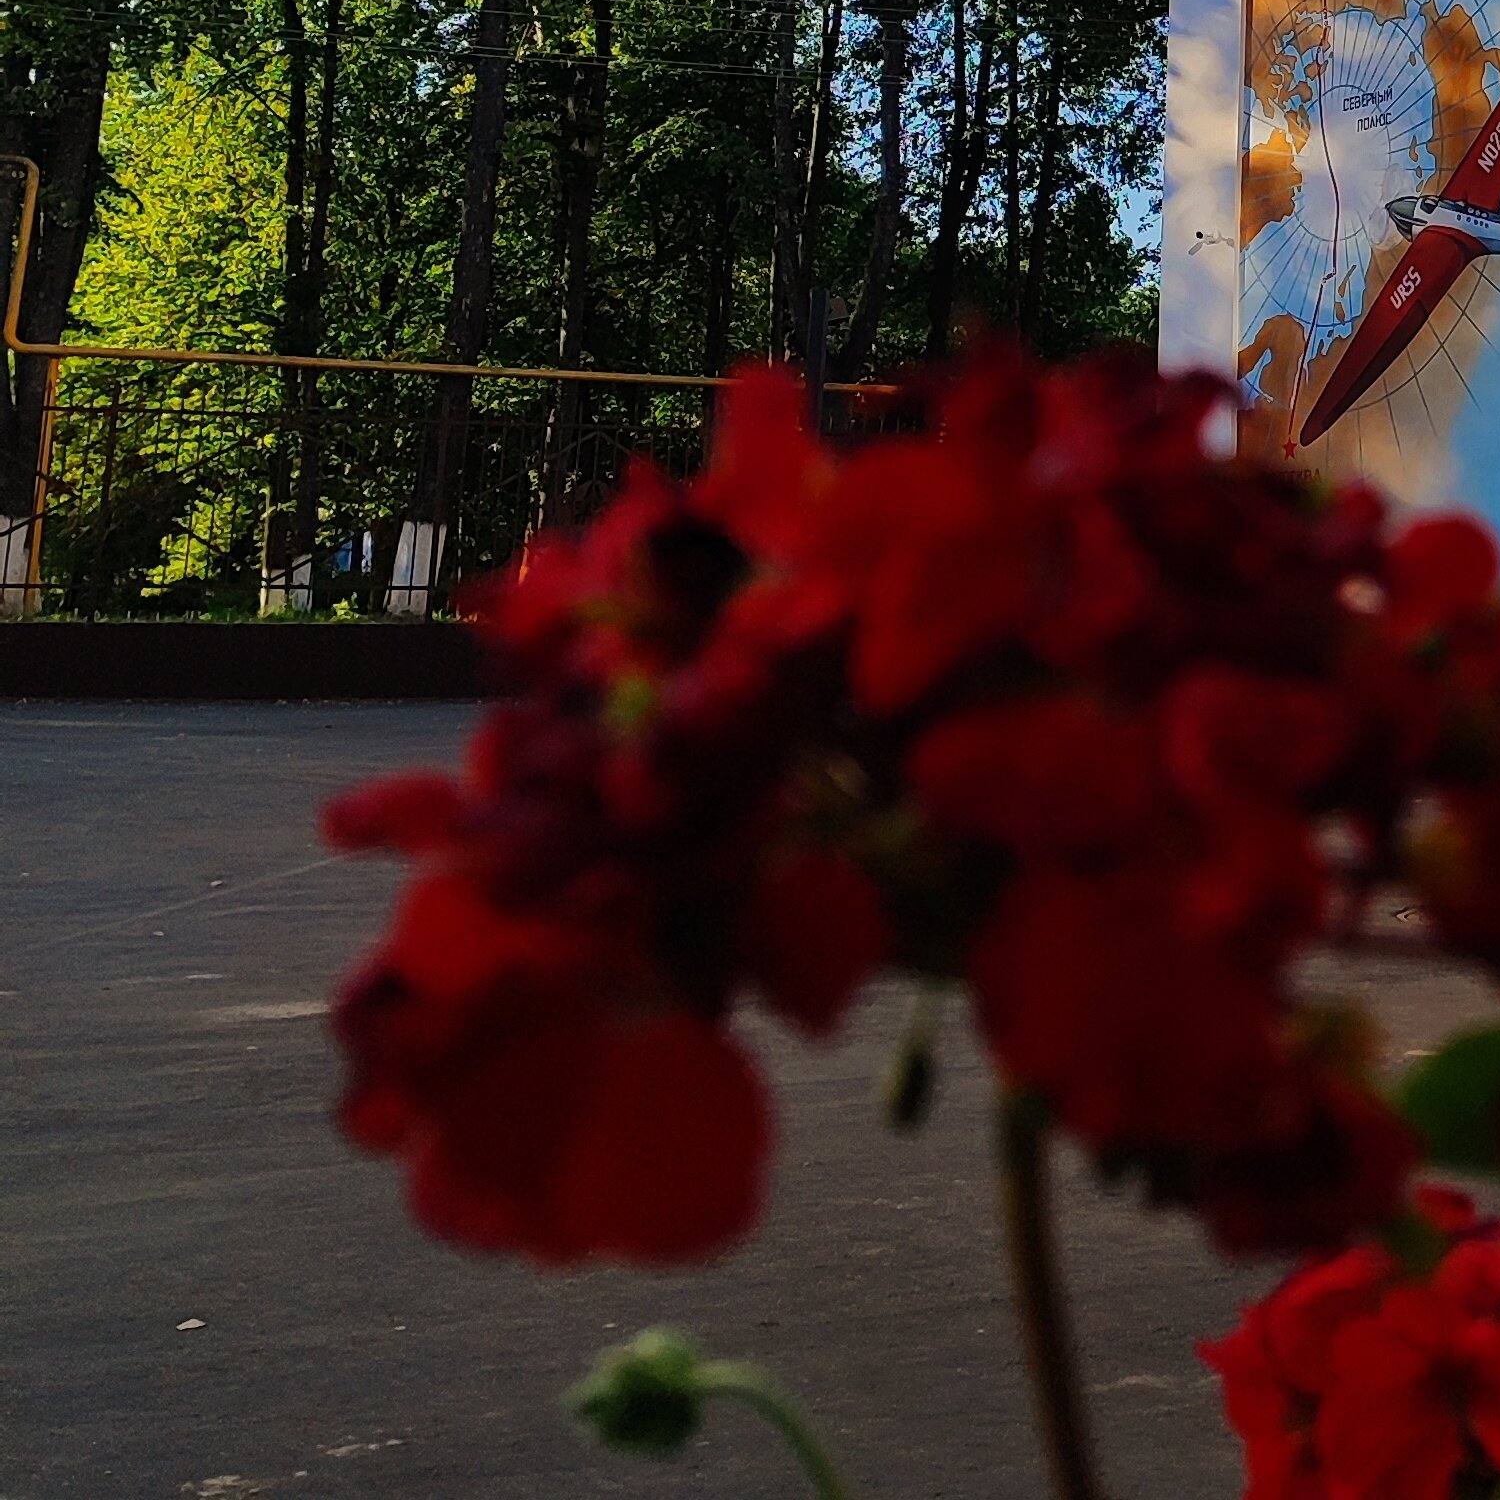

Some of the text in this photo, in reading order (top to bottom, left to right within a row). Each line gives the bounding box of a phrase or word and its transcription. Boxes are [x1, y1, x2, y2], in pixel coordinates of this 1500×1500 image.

[1342, 86, 1393, 112] СЕВЕРНЫЙ
[1357, 112, 1392, 132] ПОЛЮС
[1390, 266, 1422, 310] URSS
